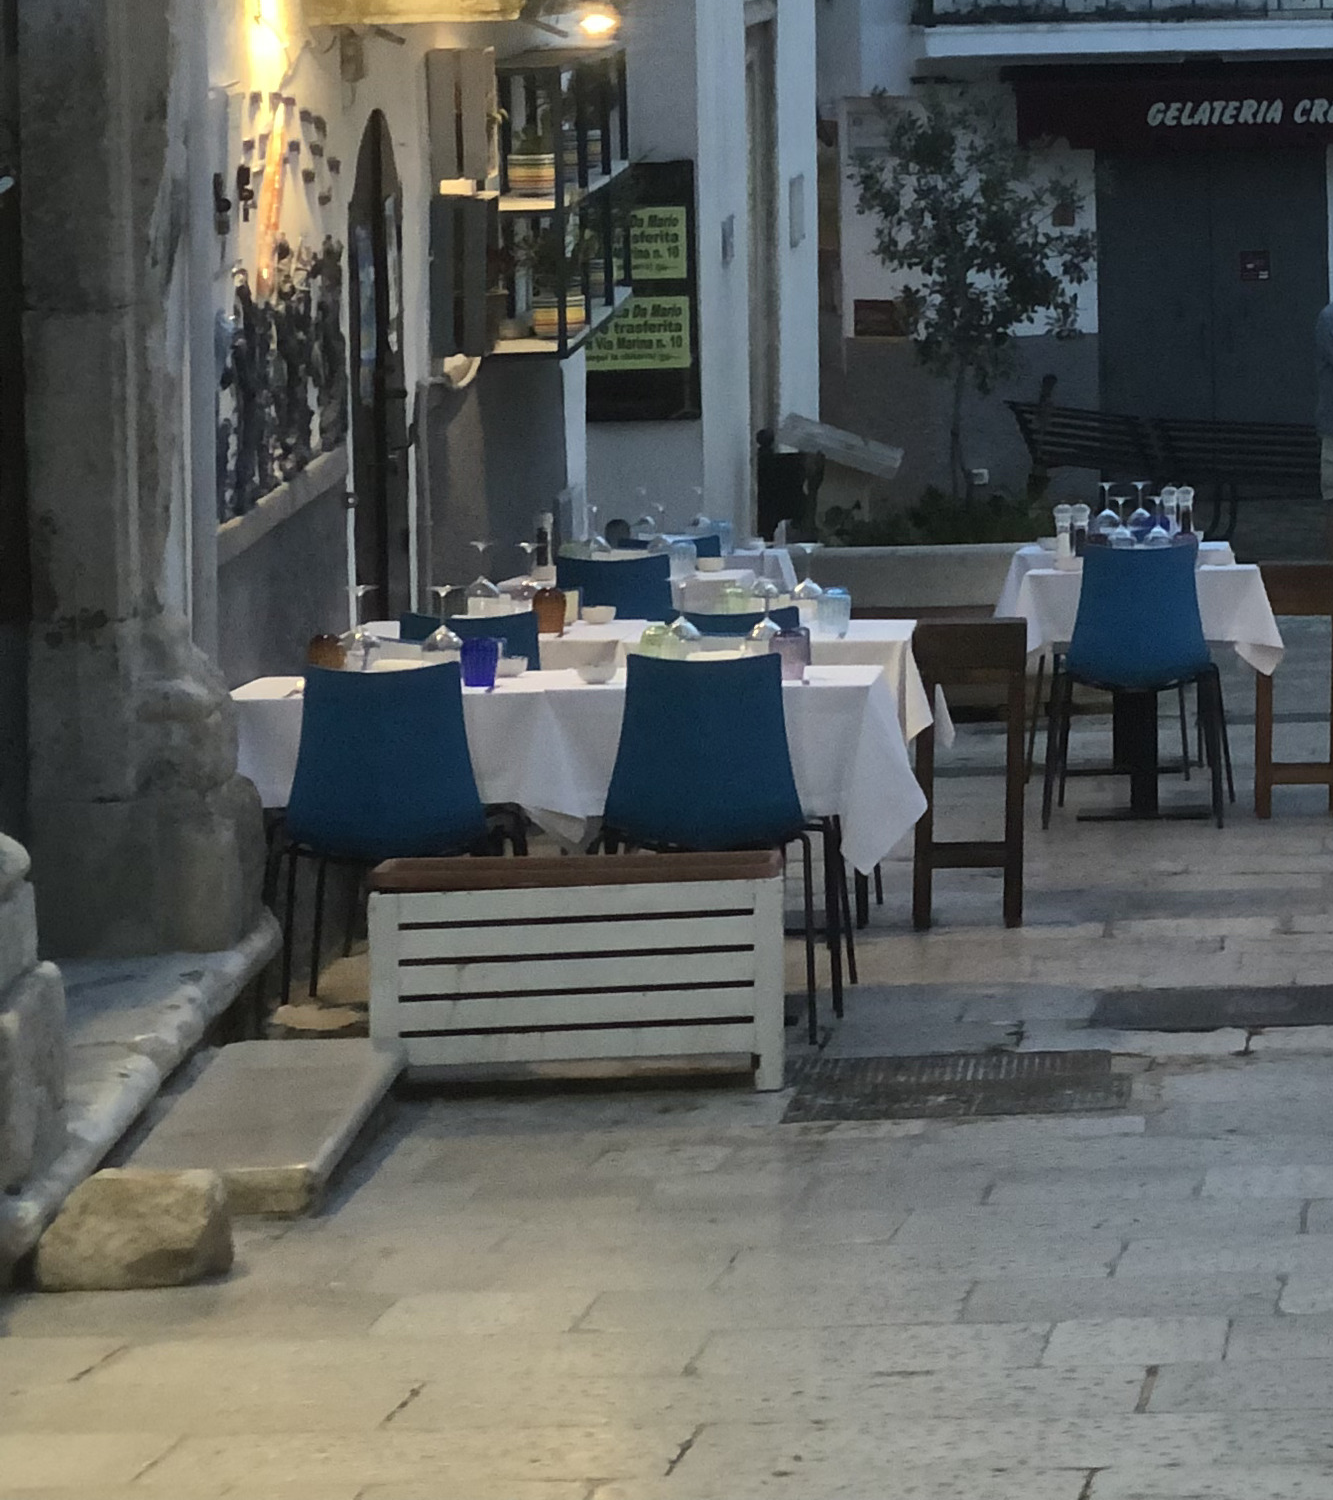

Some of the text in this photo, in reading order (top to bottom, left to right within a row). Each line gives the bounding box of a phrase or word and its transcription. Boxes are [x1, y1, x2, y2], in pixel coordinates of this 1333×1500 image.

[1146, 100, 1283, 127] GELATERIA
[647, 215, 679, 227] Mario
[632, 305, 647, 318] Da
[650, 304, 682, 317] Mario
[613, 321, 682, 334] trasferita
[595, 337, 613, 350] Via
[669, 335, 682, 348] 10
